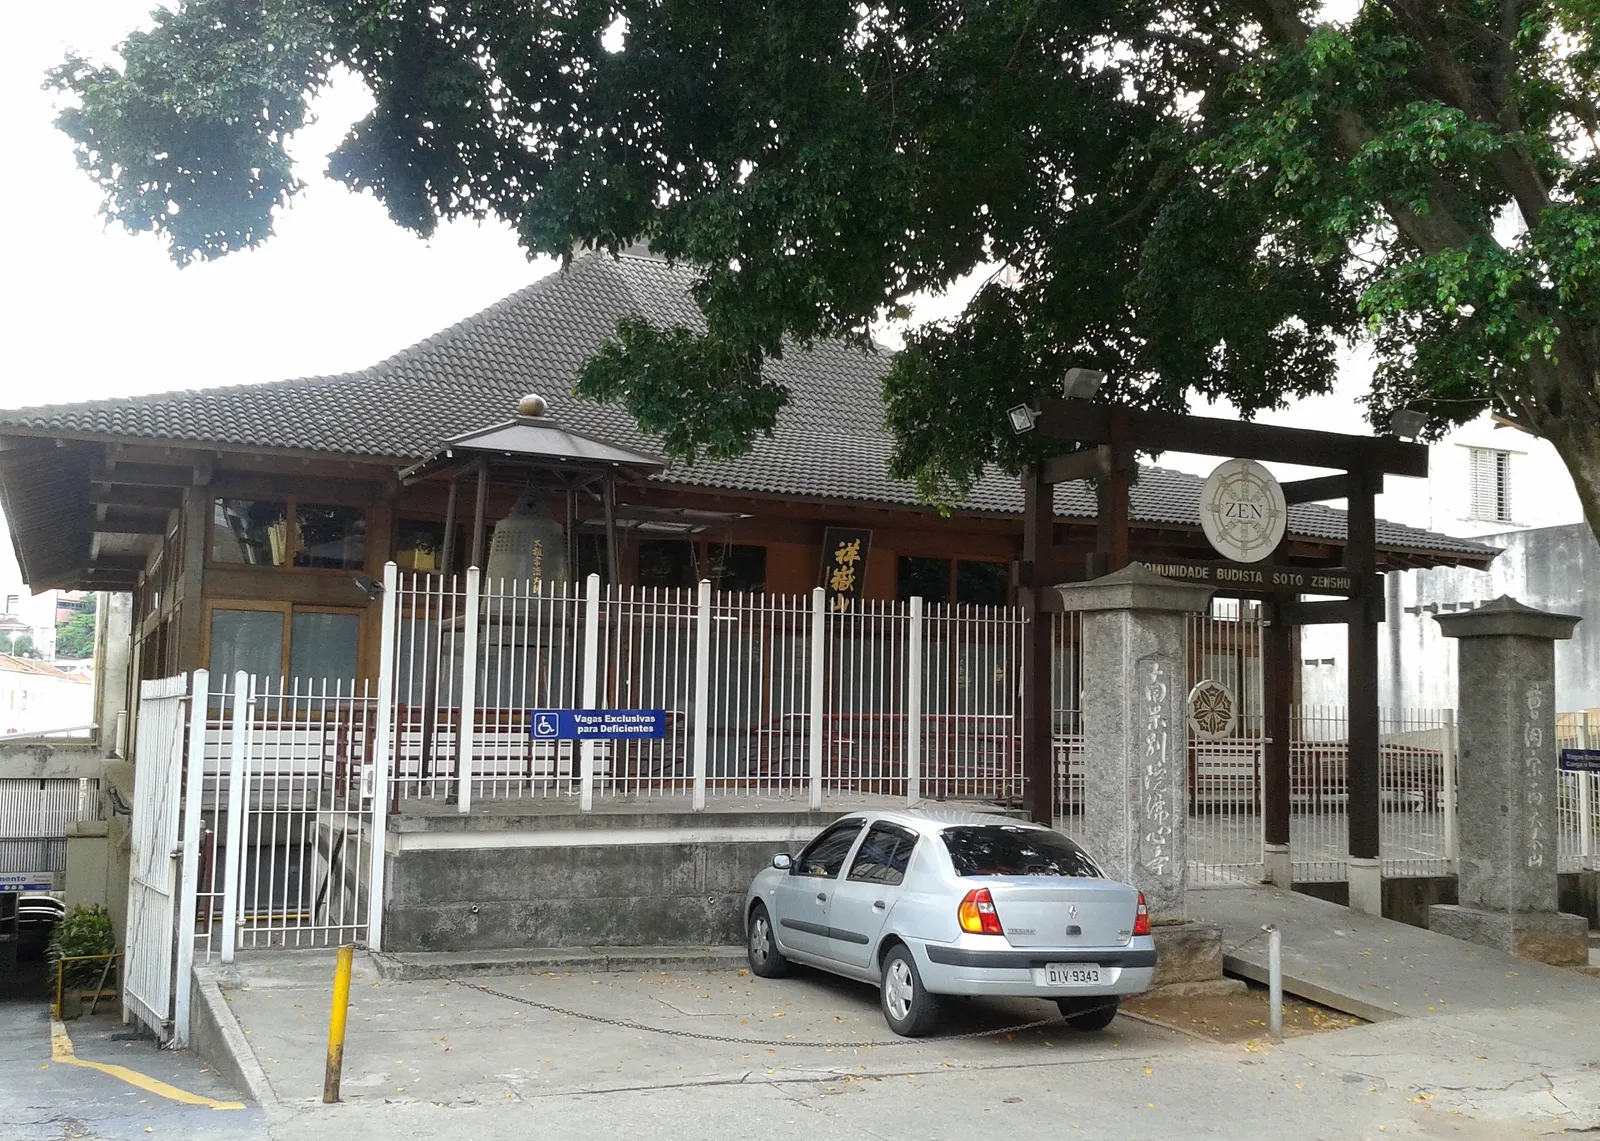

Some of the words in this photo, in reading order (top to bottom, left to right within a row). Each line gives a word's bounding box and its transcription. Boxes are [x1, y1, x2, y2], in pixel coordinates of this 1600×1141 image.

[1225, 502, 1263, 518] ZEN
[1139, 562, 1209, 579] OMUNIDADE
[1216, 568, 1263, 583] BUDISTA
[1272, 573, 1304, 586] SOTO
[1311, 576, 1351, 589] ZENSHU
[574, 714, 602, 724] Vagas
[604, 714, 656, 723] Exclusivas
[577, 725, 598, 734] para
[600, 724, 654, 733] Deficientes
